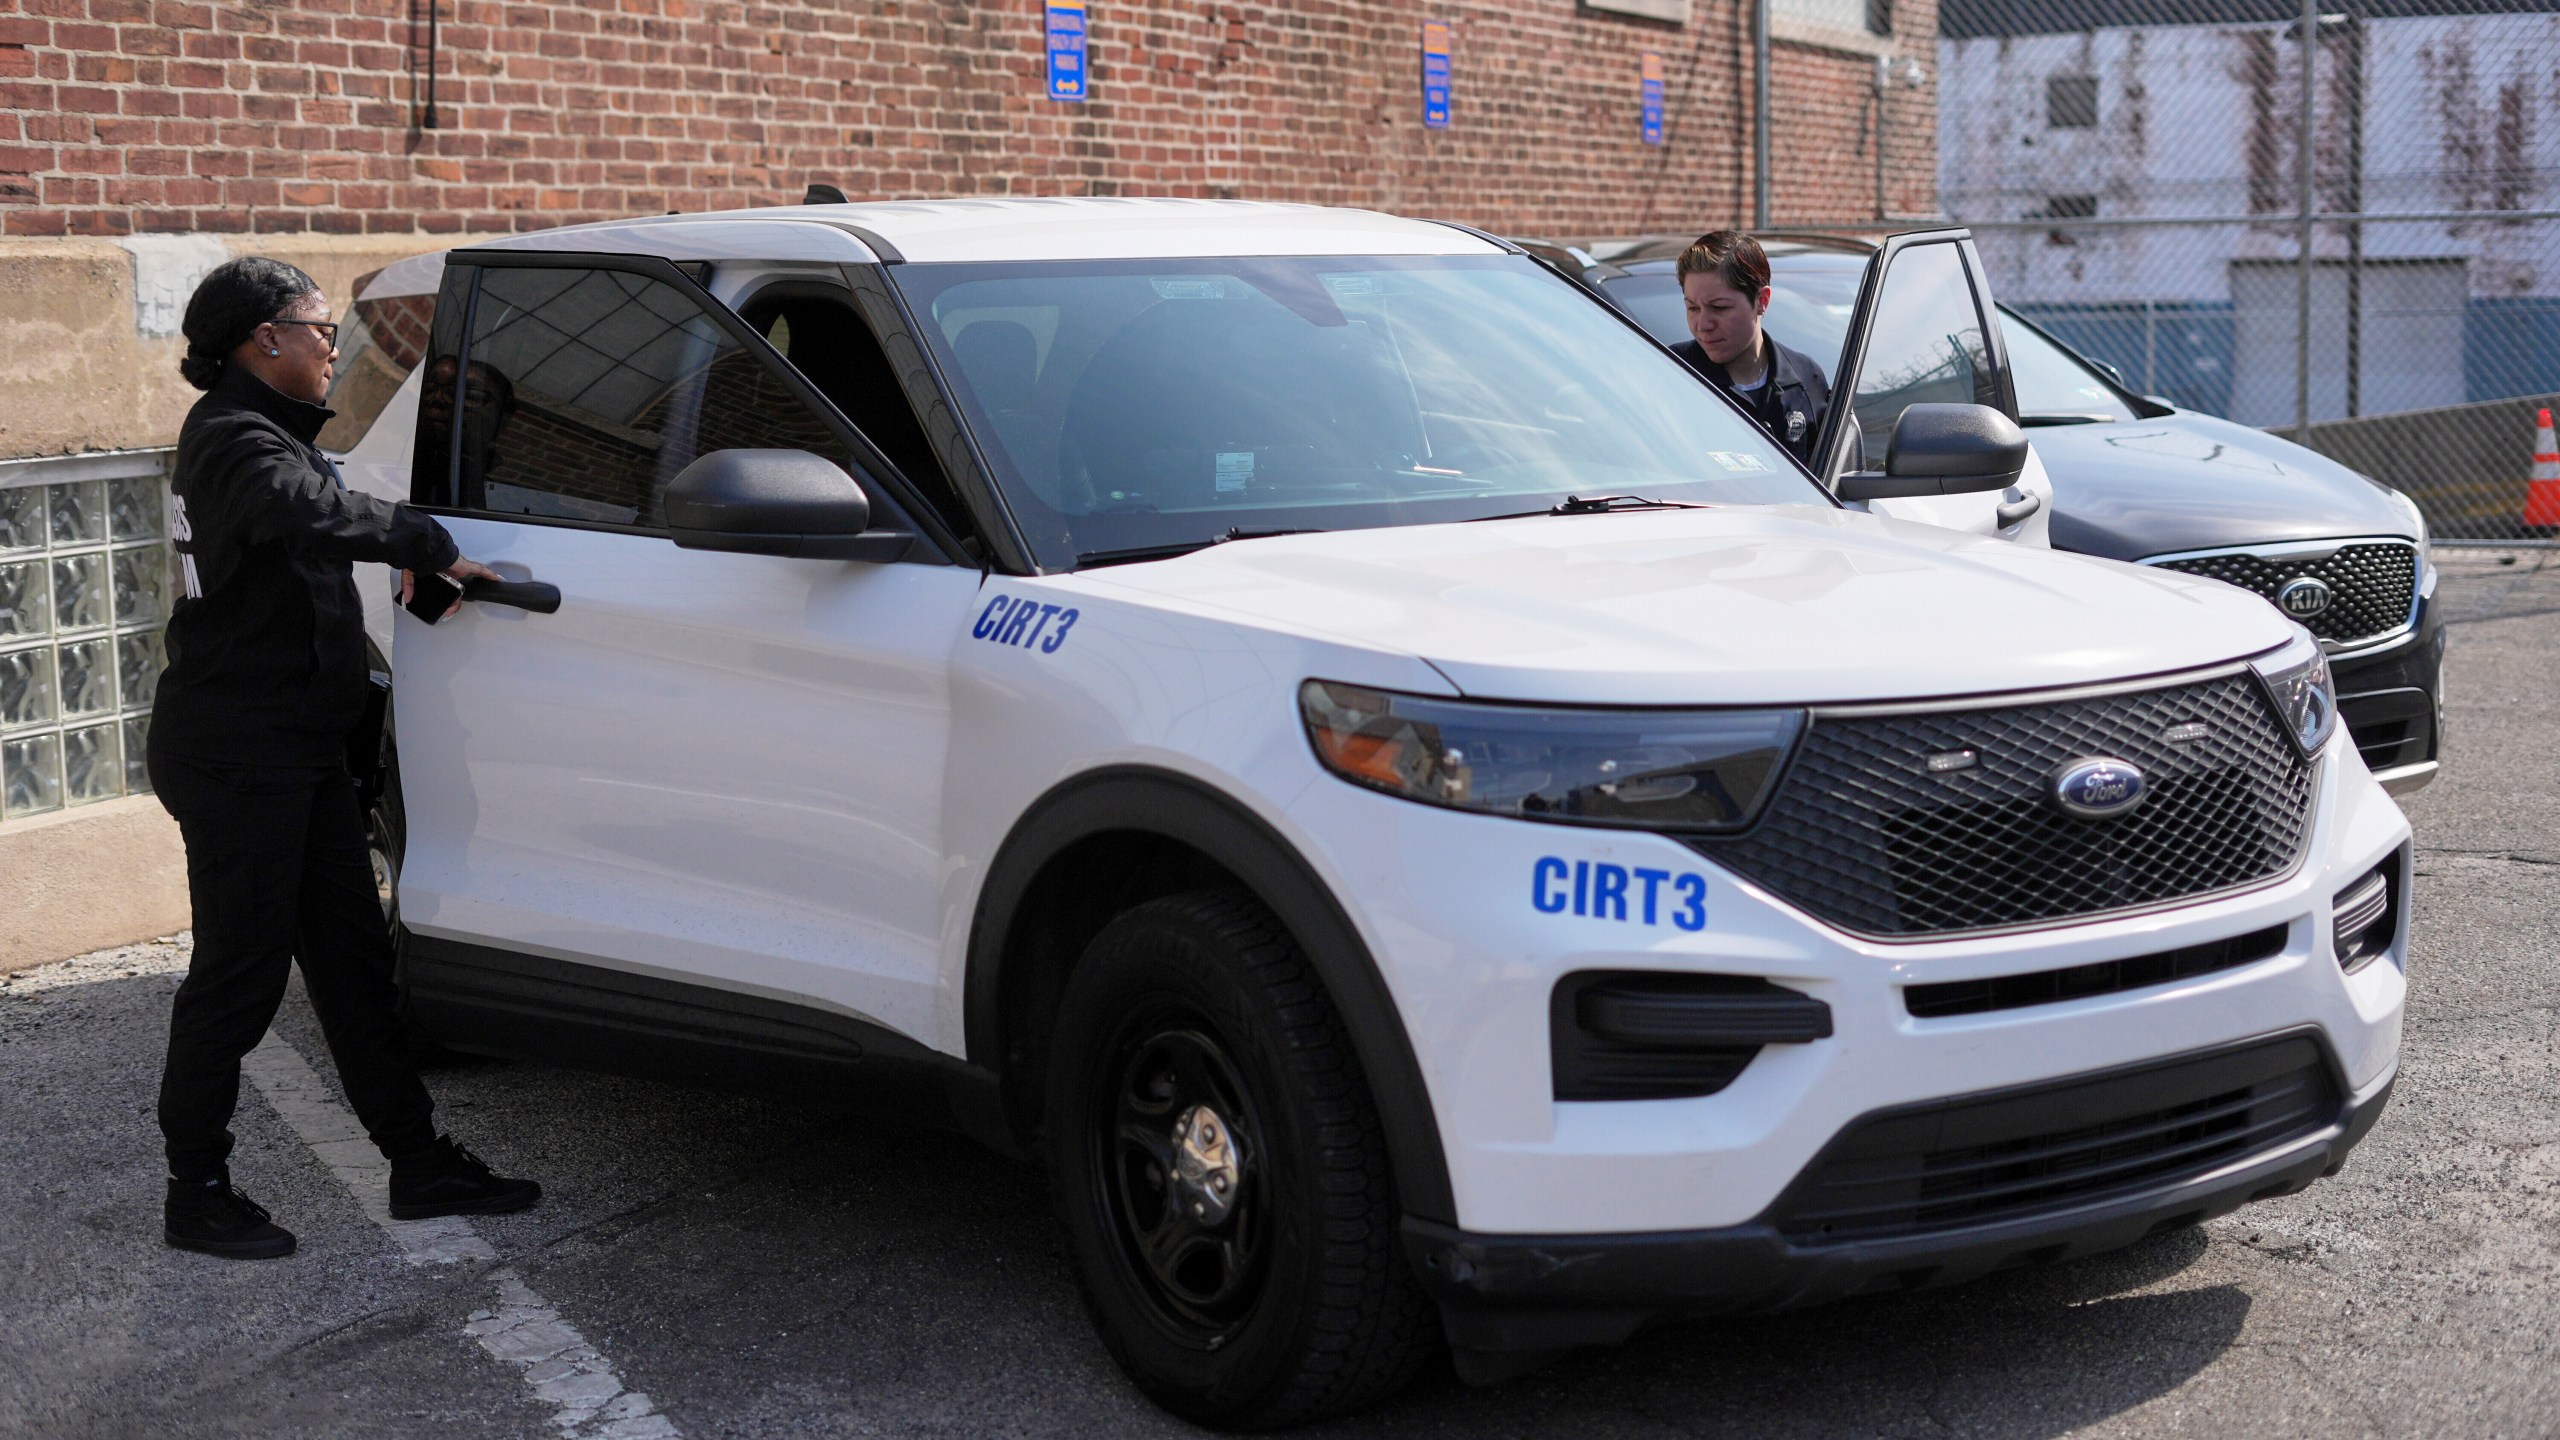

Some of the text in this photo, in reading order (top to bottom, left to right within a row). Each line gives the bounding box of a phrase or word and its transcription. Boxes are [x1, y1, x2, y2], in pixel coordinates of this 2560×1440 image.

[2291, 588, 2324, 611] KIA
[972, 594, 1080, 654] CIRT3
[2083, 772, 2128, 803] Ford
[1532, 856, 1707, 932] CIRT3
